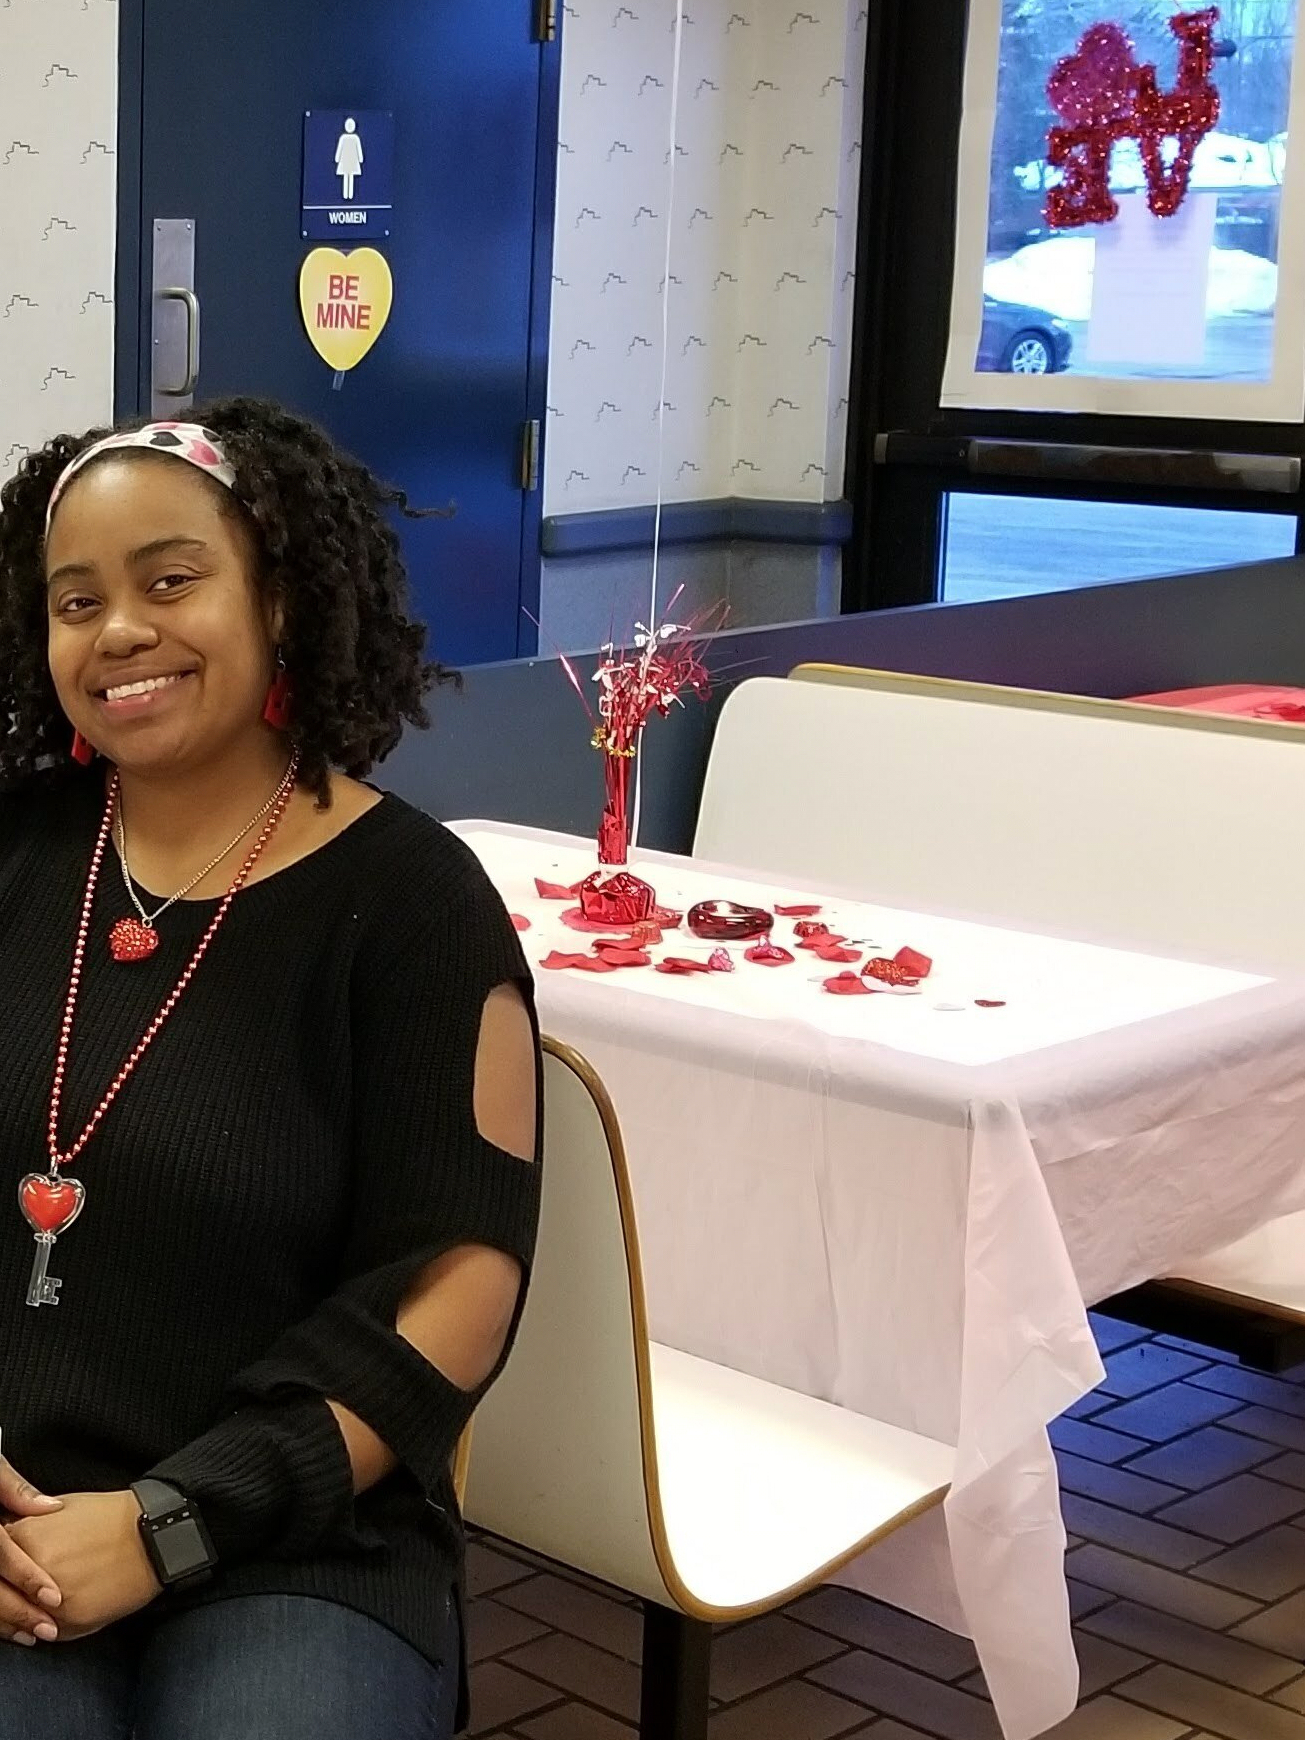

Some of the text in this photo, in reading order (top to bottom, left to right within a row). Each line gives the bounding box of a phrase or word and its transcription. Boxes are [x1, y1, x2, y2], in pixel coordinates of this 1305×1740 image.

[329, 212, 367, 224] WOMEN
[329, 274, 360, 300] BE
[316, 303, 371, 330] MINE
